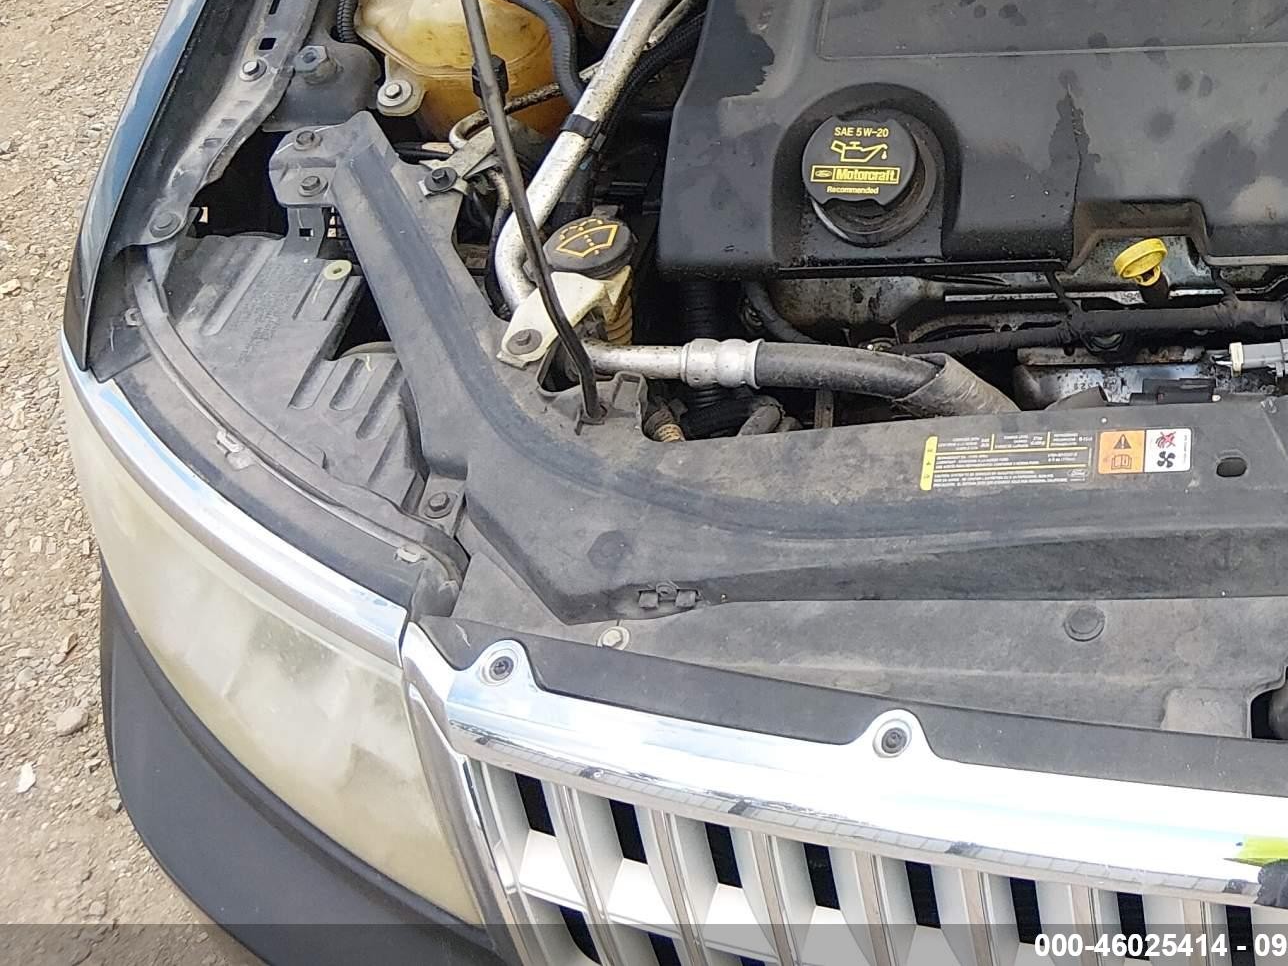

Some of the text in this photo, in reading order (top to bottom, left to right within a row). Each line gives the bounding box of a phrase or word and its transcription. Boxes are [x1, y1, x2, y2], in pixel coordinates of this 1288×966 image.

[834, 126, 889, 138] SAE 5W-20
[826, 185, 879, 195] Recommended
